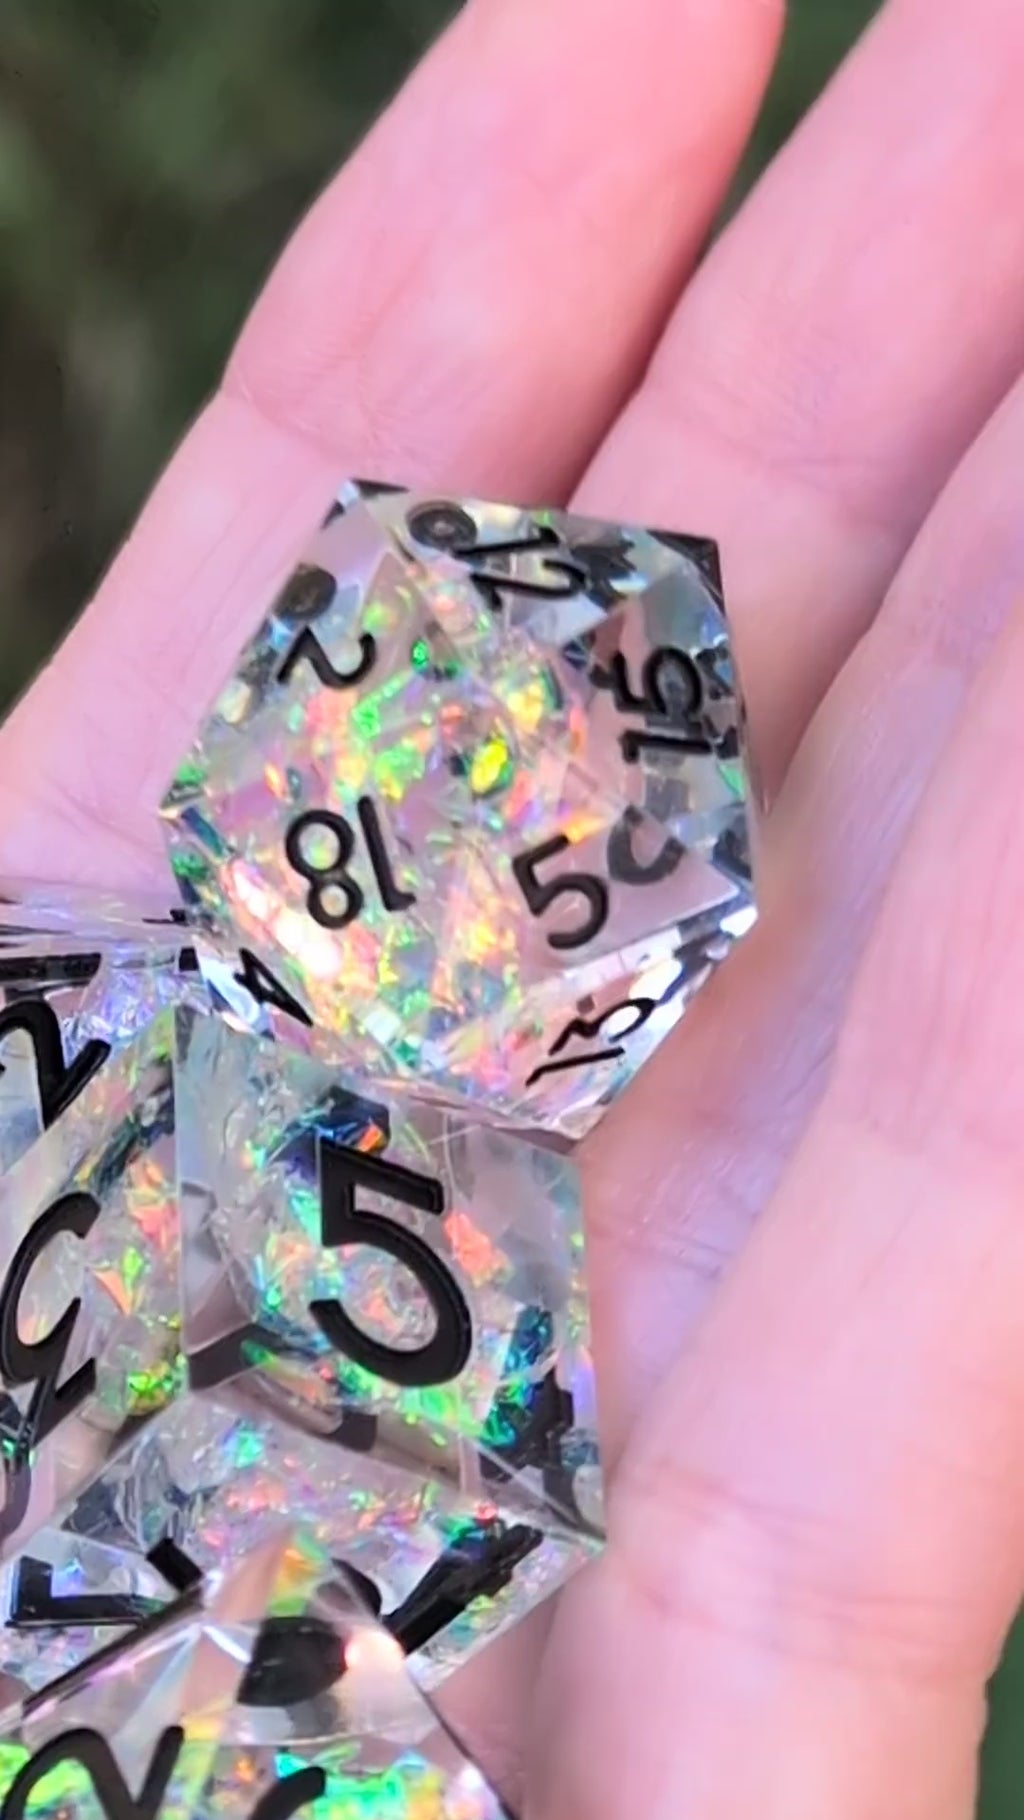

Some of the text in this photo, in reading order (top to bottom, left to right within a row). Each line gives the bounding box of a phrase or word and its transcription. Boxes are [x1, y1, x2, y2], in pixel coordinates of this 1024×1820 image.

[276, 626, 376, 689] 2
[285, 796, 417, 930] 18
[512, 833, 609, 951] 5
[309, 1137, 473, 1387] 5
